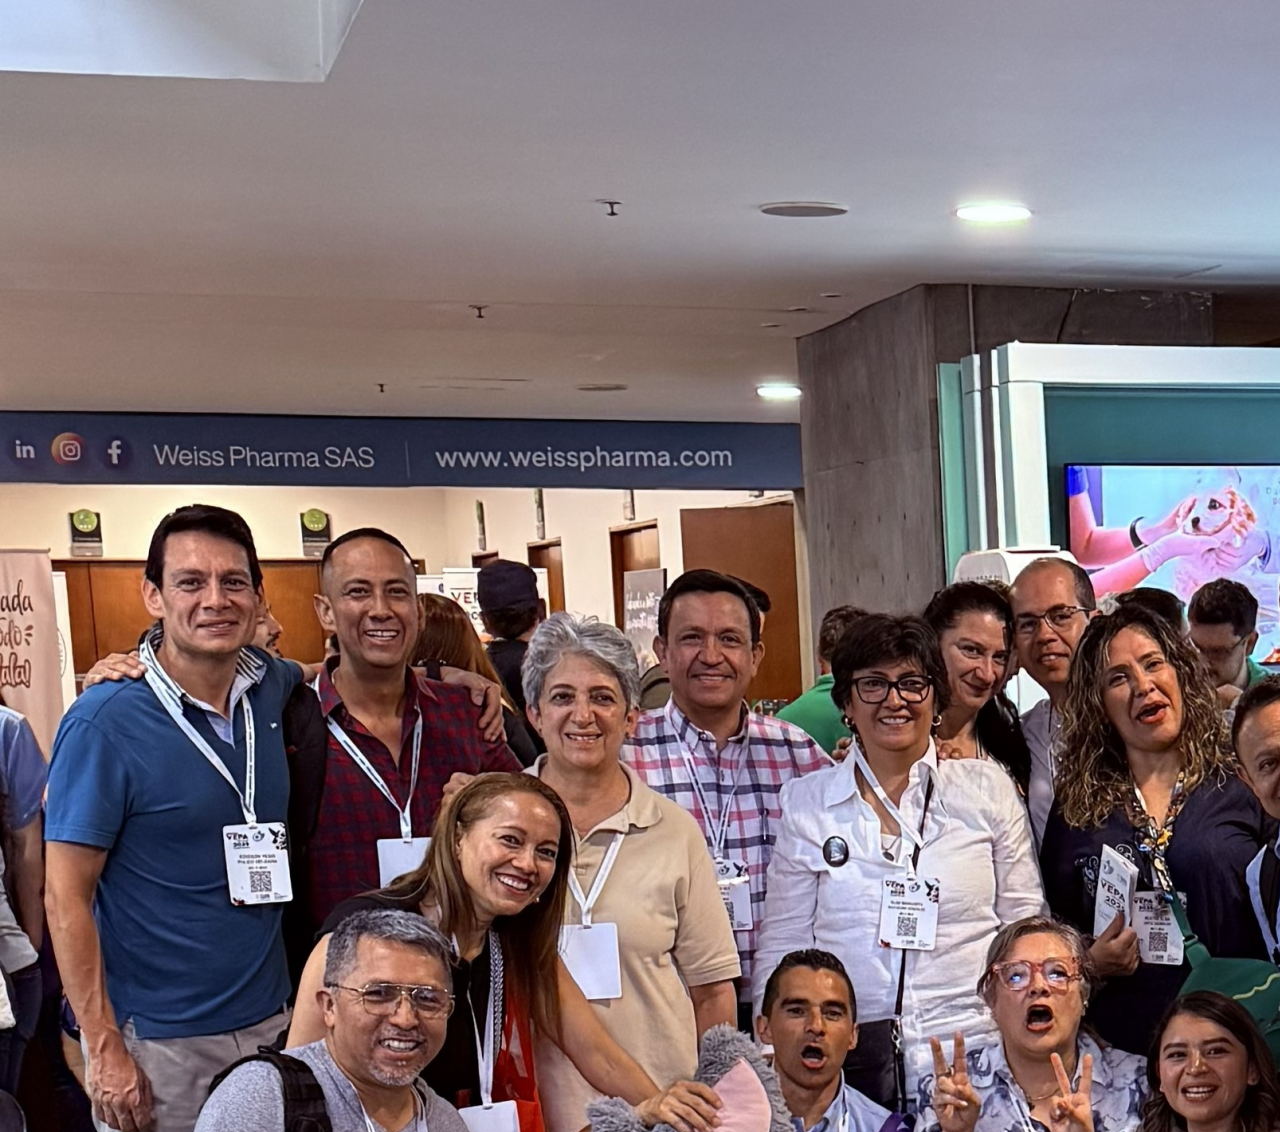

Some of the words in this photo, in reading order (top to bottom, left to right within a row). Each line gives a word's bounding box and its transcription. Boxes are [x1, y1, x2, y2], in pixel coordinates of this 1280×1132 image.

[153, 444, 224, 467] Weiss
[230, 447, 320, 467] Pharma
[325, 447, 374, 468] SAS
[435, 446, 732, 471] www.weisspharma.com
[1100, 880, 1125, 903] VEPA
